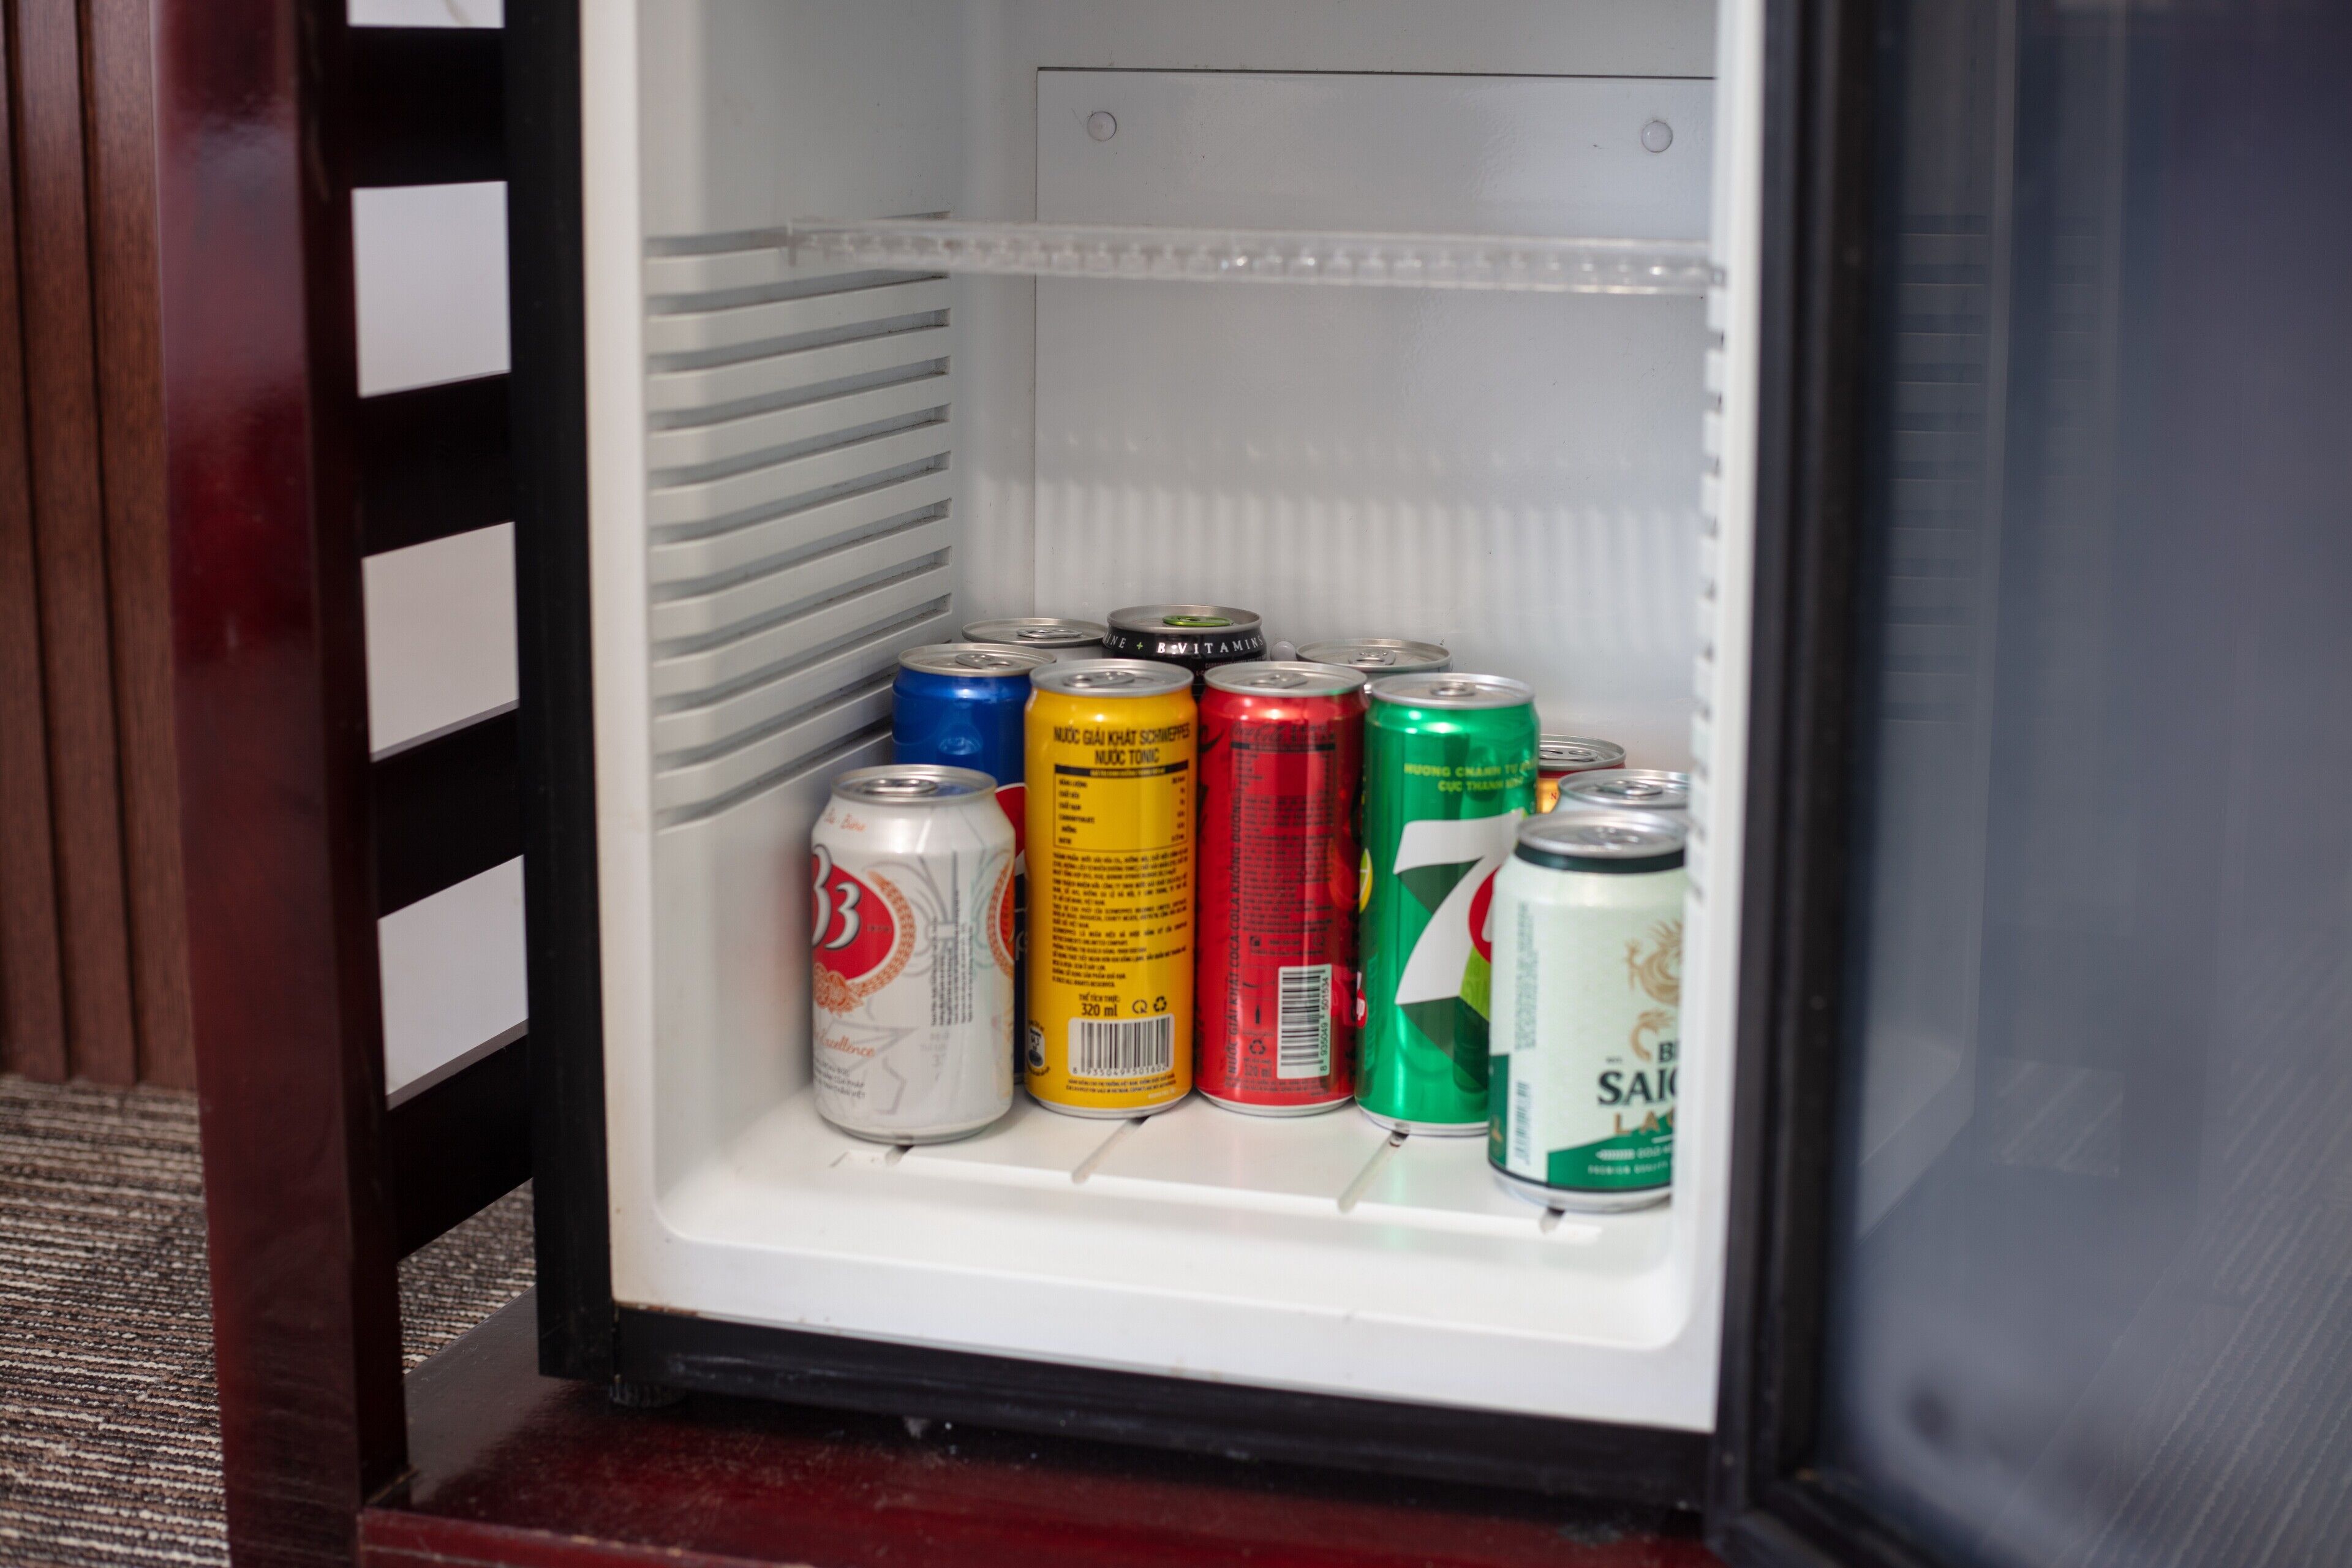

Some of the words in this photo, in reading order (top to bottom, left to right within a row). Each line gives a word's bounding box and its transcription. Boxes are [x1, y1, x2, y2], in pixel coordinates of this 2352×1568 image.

[1128, 748, 1160, 764] TONIC
[1081, 1003, 1100, 1016] 320
[1104, 1004, 1118, 1016] ml
